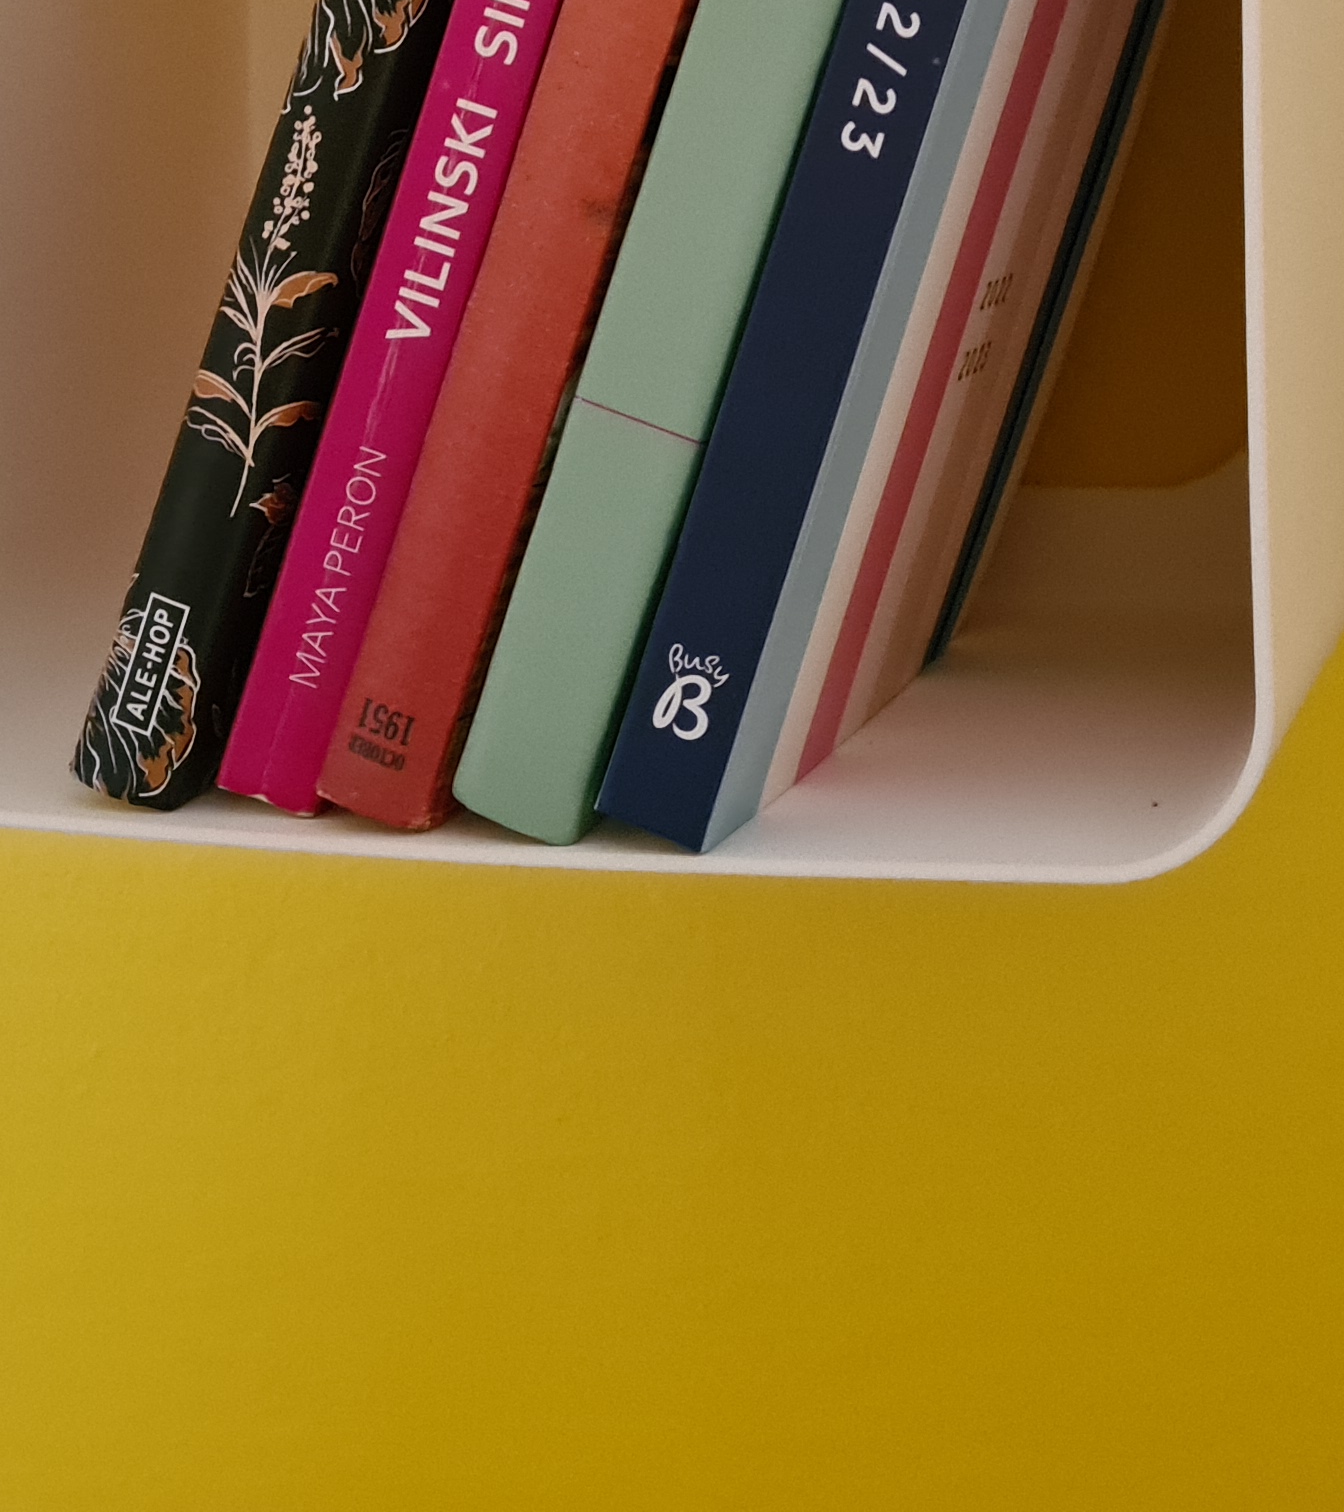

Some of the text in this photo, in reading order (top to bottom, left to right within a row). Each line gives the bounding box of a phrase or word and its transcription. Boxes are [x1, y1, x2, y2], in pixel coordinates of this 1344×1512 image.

[385, 98, 498, 340] VILINSKI
[289, 446, 387, 688] MAYA PERON
[127, 608, 174, 721] ALE-HOP
[358, 697, 416, 746] 1951
